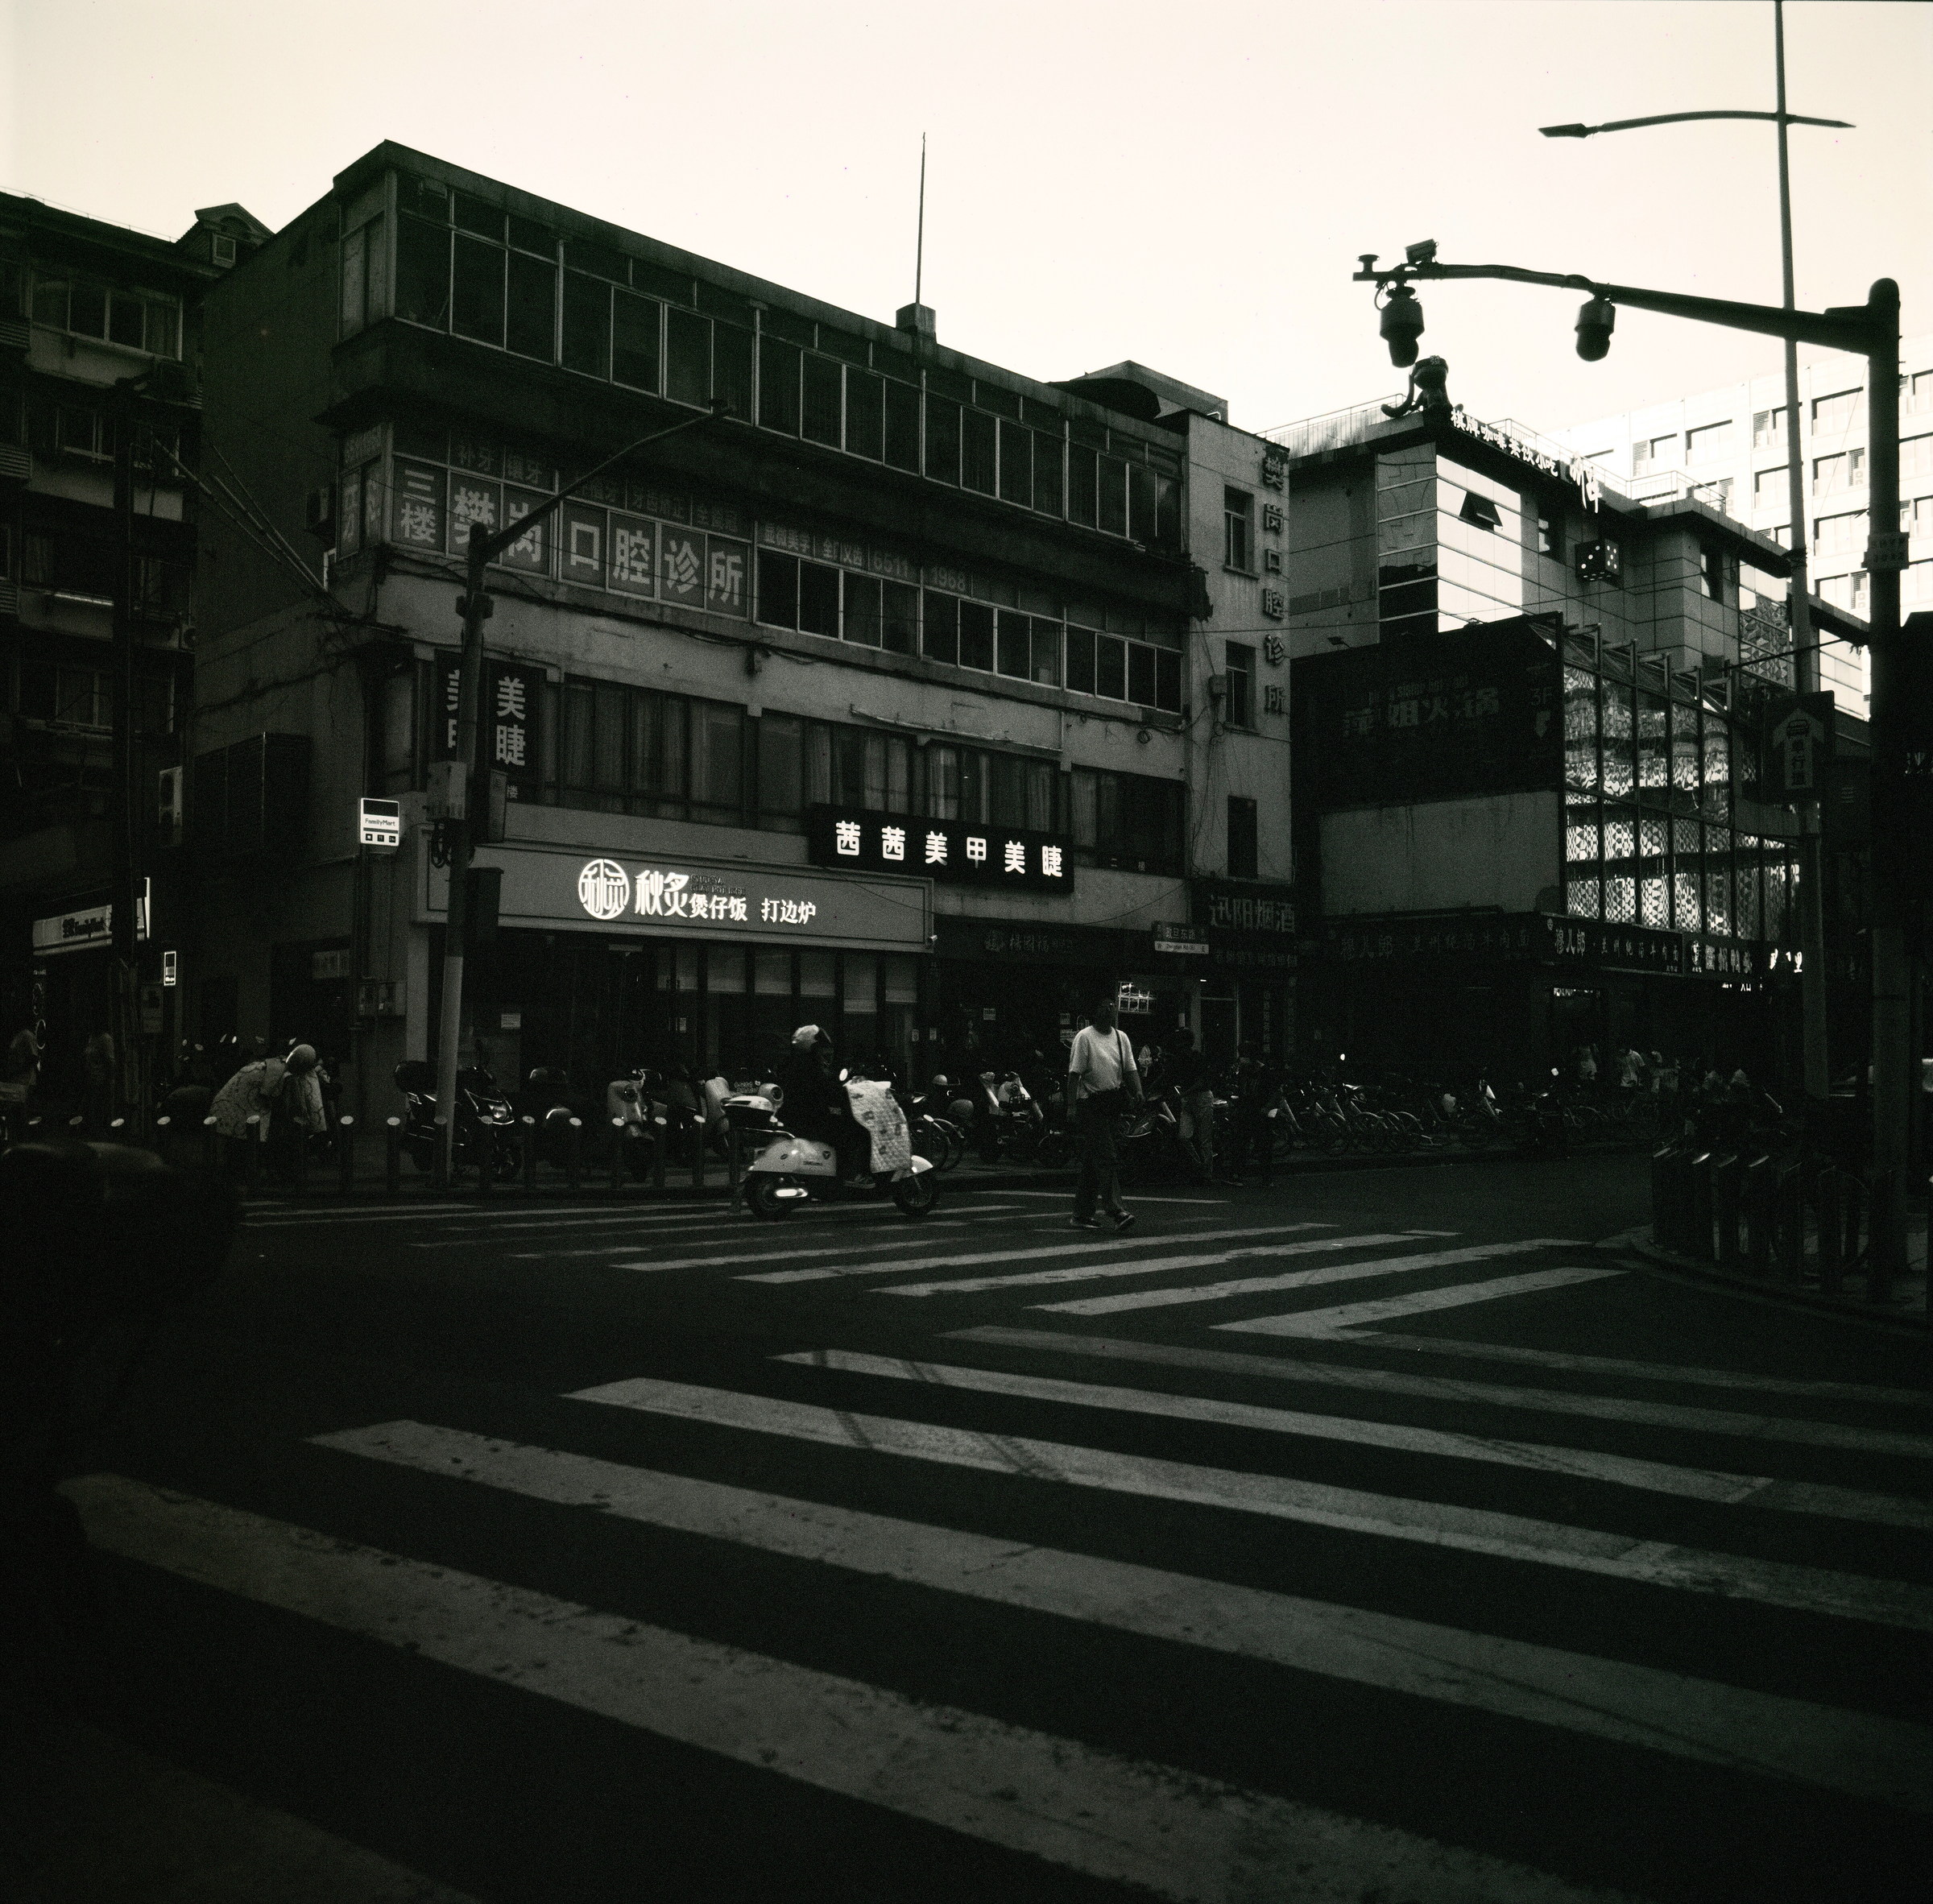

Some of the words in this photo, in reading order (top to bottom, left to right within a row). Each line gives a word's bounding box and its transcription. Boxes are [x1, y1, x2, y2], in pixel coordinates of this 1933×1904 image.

[1451, 408, 1558, 477] 棋牌咖啡茶饮小吃
[400, 469, 437, 544] 三楼
[873, 551, 909, 578] 6511
[931, 565, 966, 592] 1968
[1530, 686, 1554, 706] 3F
[496, 676, 526, 766] 美睫
[365, 817, 395, 826] FamilyMart
[836, 820, 1062, 877] 茜茜美甲美睫
[689, 893, 748, 921] 煲仔饭
[761, 897, 817, 925] 打边炉
[1208, 894, 1295, 933] 迅阳烟酒
